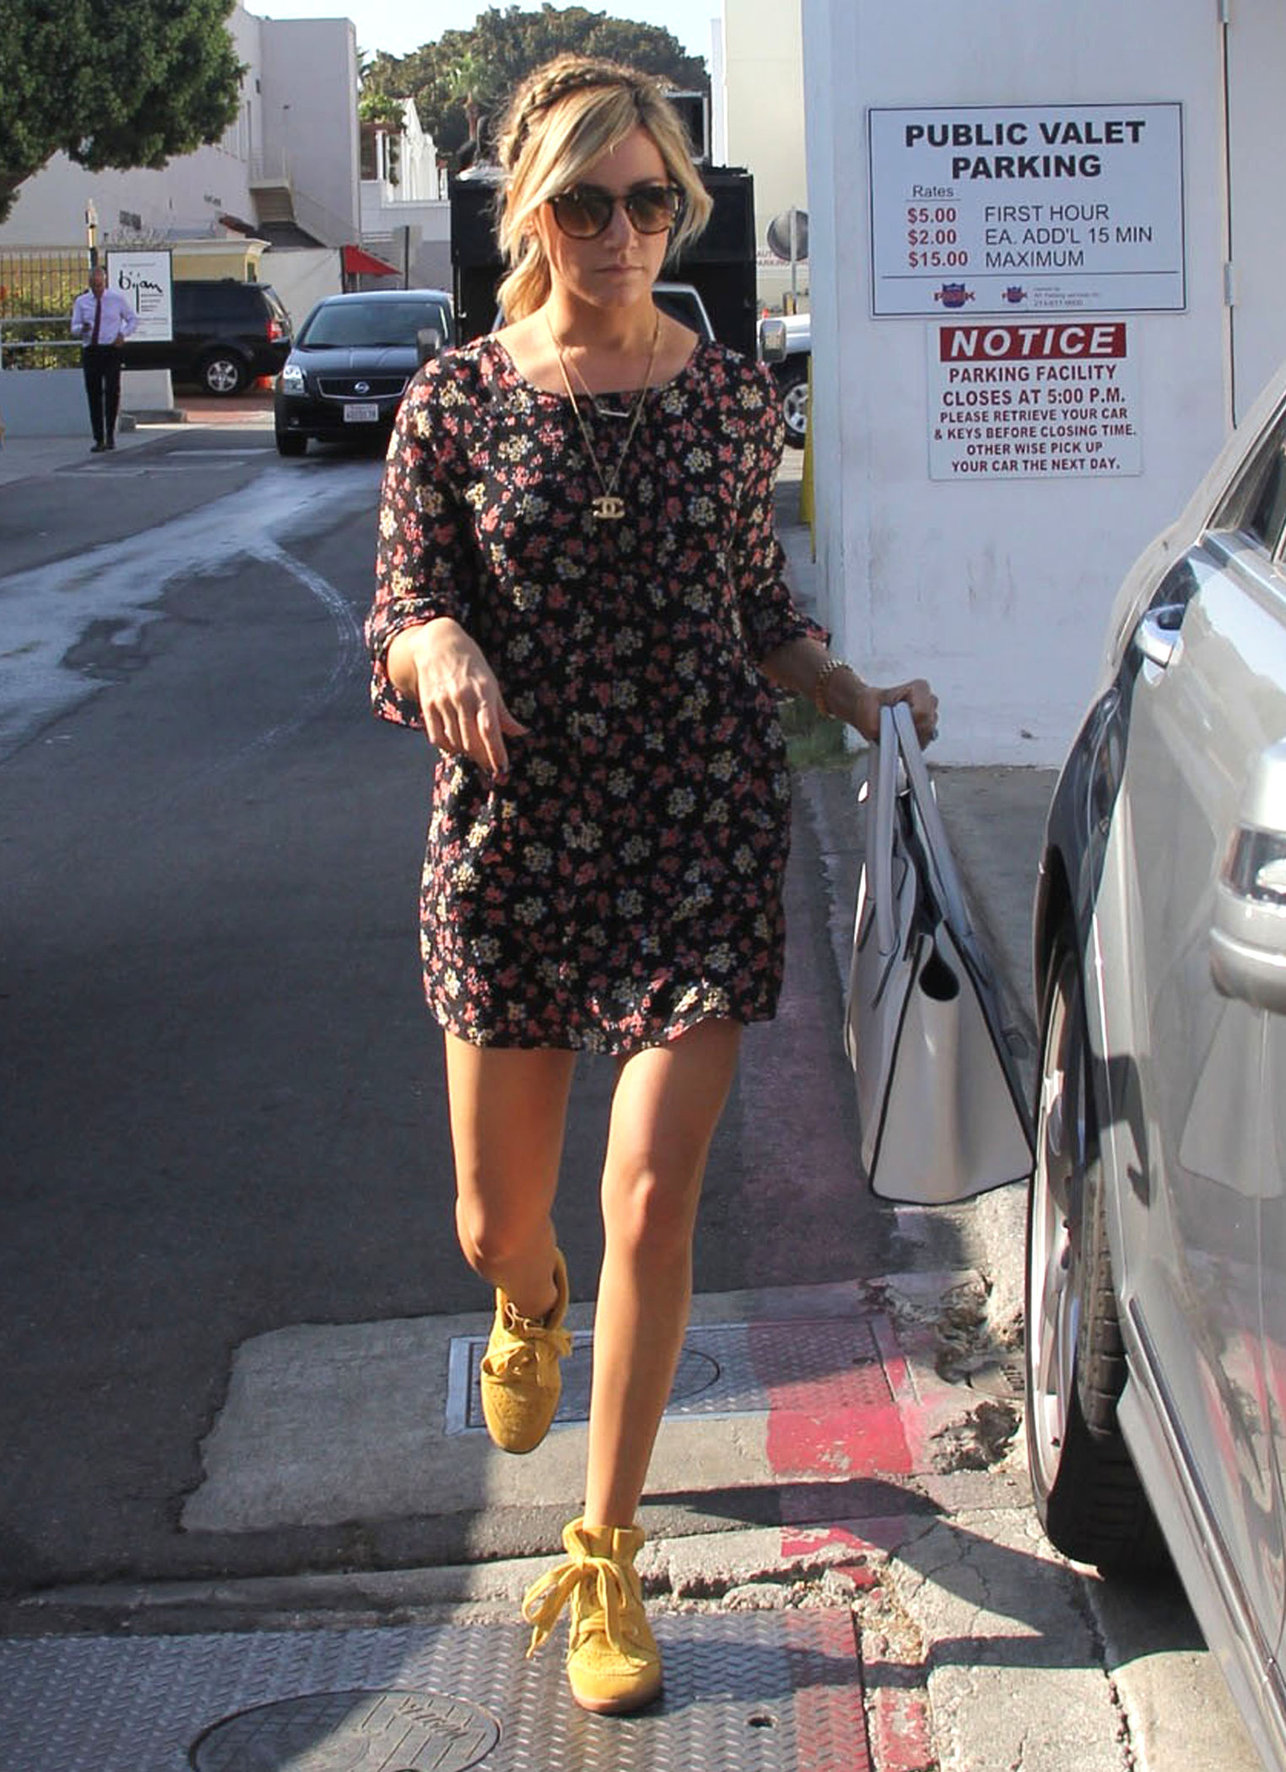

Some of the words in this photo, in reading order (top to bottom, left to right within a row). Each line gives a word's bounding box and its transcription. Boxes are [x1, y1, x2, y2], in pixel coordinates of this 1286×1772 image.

[905, 122, 1028, 147] PUBLIC
[1039, 121, 1146, 144] VALET
[952, 154, 1101, 179] PARKING
[912, 184, 954, 198] Rates
[907, 207, 957, 224] $5.00
[984, 206, 1043, 222] FIRST
[1049, 204, 1110, 221] HOUR
[907, 229, 957, 246] $2.00
[985, 228, 1017, 245] EA.
[1022, 227, 1081, 245] ADD'L
[1088, 228, 1110, 243] 15
[1115, 226, 1153, 243] MIN
[908, 250, 968, 269] $15.00
[985, 250, 1084, 267] MAXIMUM
[951, 327, 1116, 357] NOTICE
[949, 366, 1030, 383] PARKING
[1036, 364, 1117, 381] FACILITY
[943, 390, 1012, 407] CLOSES
[1018, 389, 1041, 405] AT
[1047, 388, 1084, 404] 5:00
[1089, 386, 1126, 403] P.M.
[940, 411, 989, 423] PLEASE
[993, 409, 1057, 422] RETRIEVE
[1061, 408, 1098, 420] YOUR
[1101, 407, 1128, 419] CAR
[934, 428, 943, 440] &
[947, 428, 982, 440] KEYS
[986, 427, 1037, 439] BEFORE
[1040, 425, 1098, 438] CLOSING
[1101, 423, 1137, 436] TIME.
[966, 444, 1011, 457] OTHER
[1014, 442, 1046, 455] WISE
[1051, 441, 1082, 454] PICK
[1085, 441, 1103, 453] UP
[951, 460, 989, 473] YOUR
[992, 460, 1019, 472] CAR
[1022, 459, 1048, 471] THE
[1051, 458, 1085, 471] NEXT
[1090, 457, 1121, 470] DAY.
